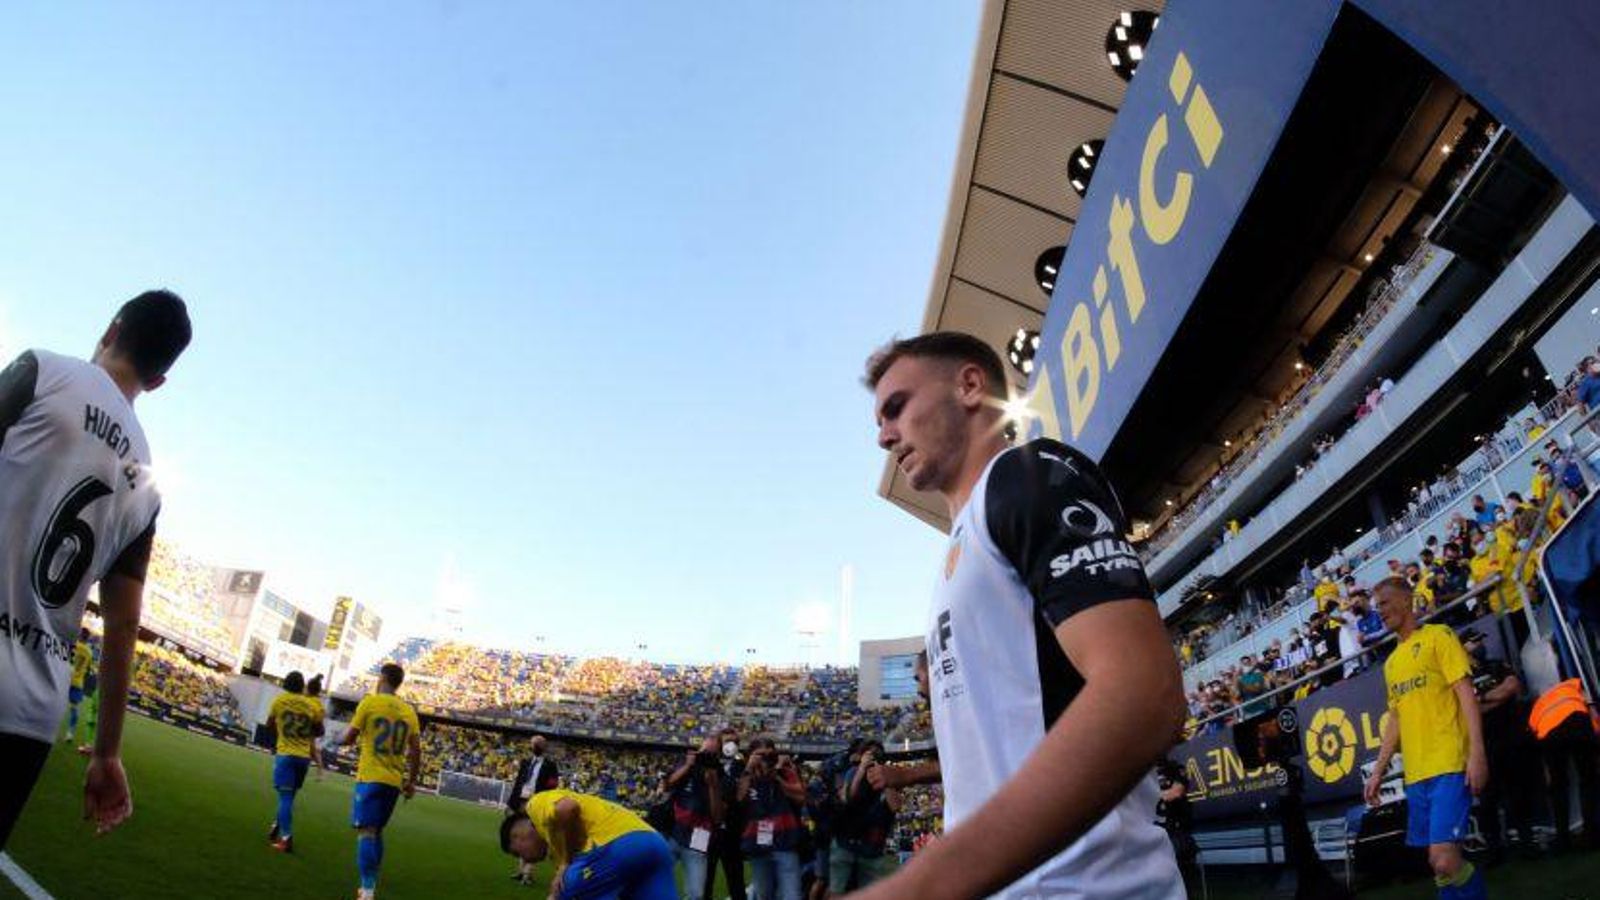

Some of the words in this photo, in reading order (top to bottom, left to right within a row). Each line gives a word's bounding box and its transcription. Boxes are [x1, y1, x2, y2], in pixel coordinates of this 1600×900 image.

[84, 403, 130, 460] HUGO
[31, 474, 115, 610] 6
[373, 715, 409, 755] 20
